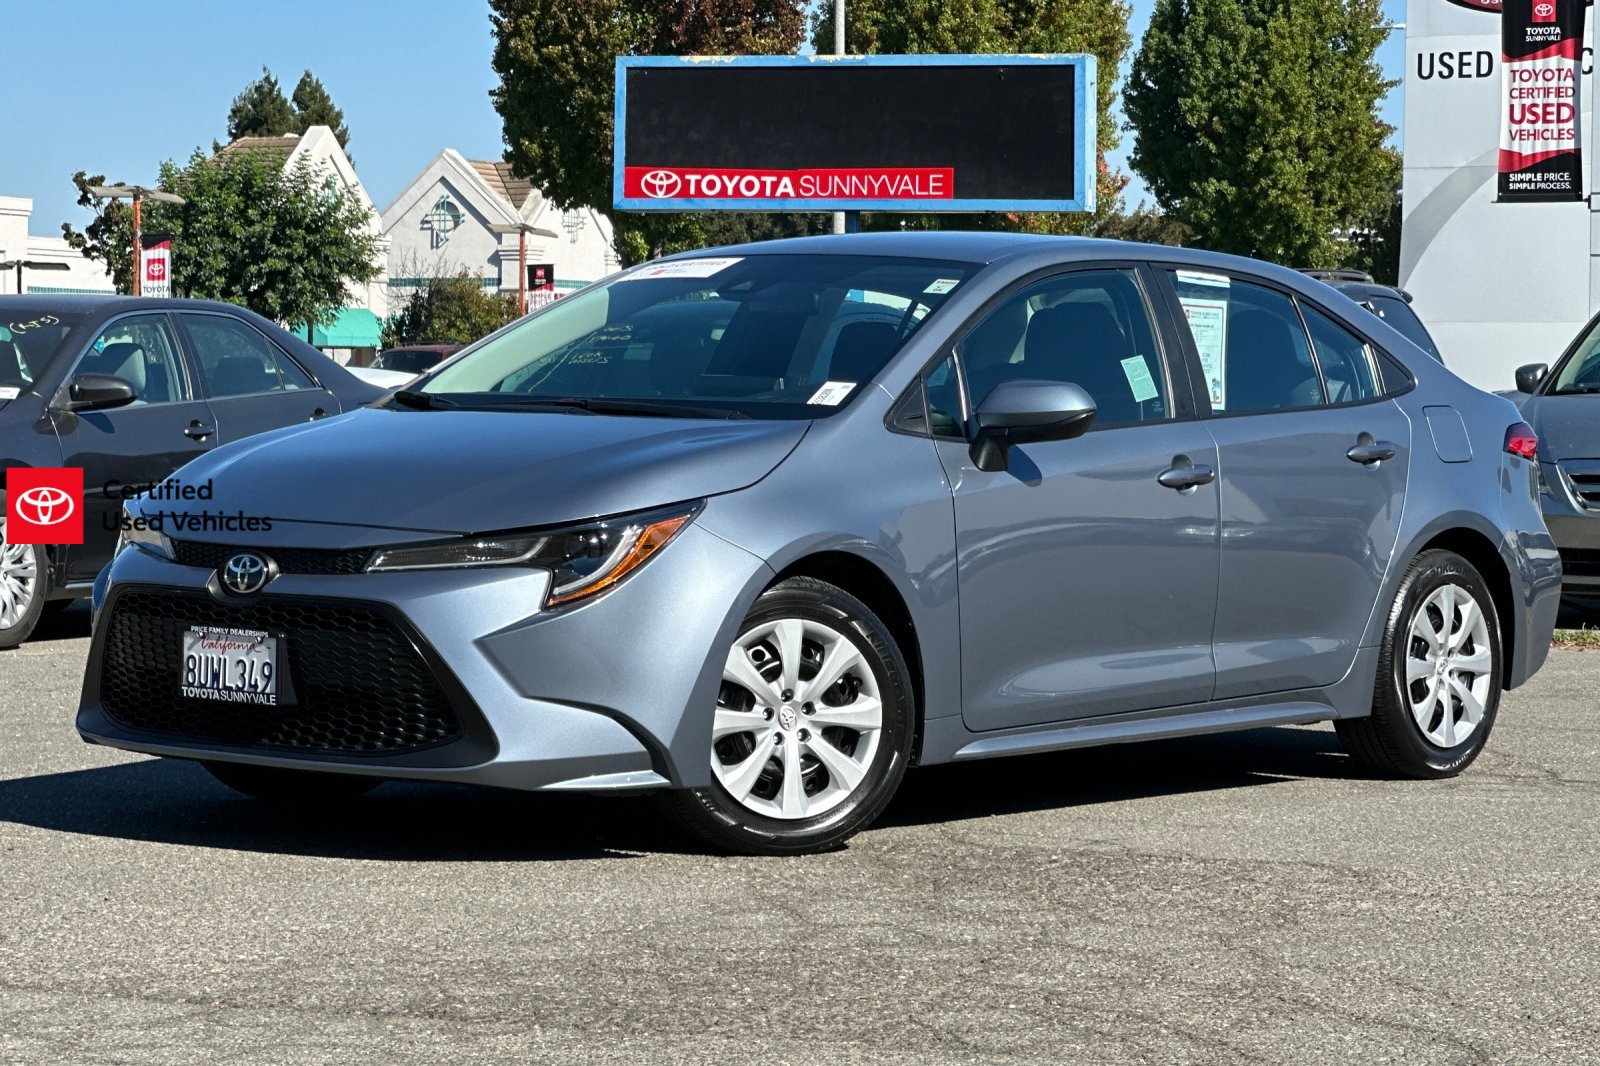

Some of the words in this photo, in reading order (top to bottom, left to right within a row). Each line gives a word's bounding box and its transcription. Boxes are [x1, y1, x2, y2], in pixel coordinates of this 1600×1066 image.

[1525, 26, 1562, 36] TOYOTA
[1417, 50, 1494, 80] USED
[1510, 68, 1575, 83] TOYOTA
[1509, 86, 1576, 100] CERTIFIED
[1509, 103, 1575, 125] USED
[1509, 128, 1575, 141] VEHICLES
[1509, 173, 1543, 181] SIMPLE
[685, 173, 796, 197] TOYOTA
[799, 174, 944, 197] SUNNYVALE
[143, 285, 170, 293] TOYOTA
[190, 625, 208, 633] PRICE
[208, 626, 229, 635] FAMILY
[229, 628, 269, 637] DEALERSHIPS
[201, 635, 262, 655] California
[186, 654, 273, 693] 8UWL349
[181, 686, 220, 700] TOYOTA
[220, 690, 277, 706] SUNNYVALE
